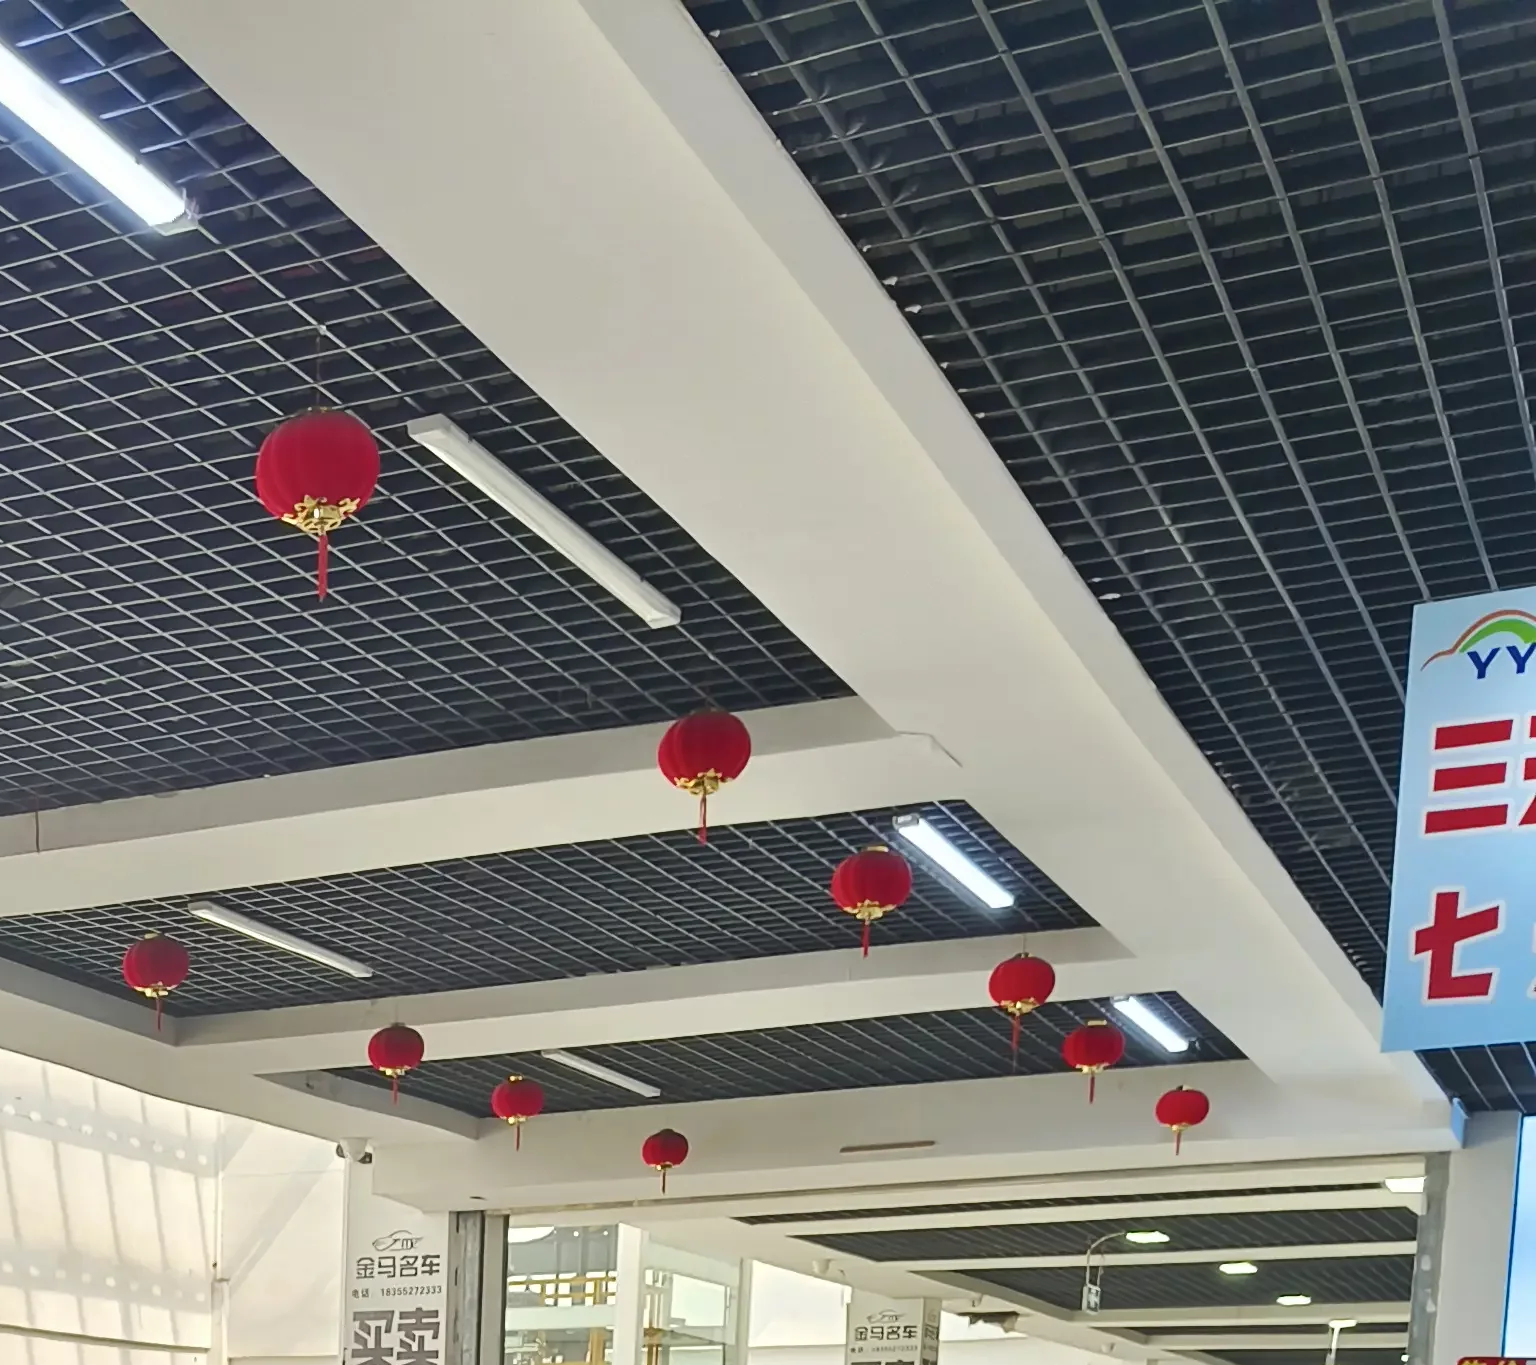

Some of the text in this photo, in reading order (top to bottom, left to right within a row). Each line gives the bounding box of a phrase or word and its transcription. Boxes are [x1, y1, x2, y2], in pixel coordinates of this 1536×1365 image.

[1424, 719, 1536, 834] 三
[356, 1254, 440, 1279] 金马名车
[855, 1325, 917, 1341] 金马名车
